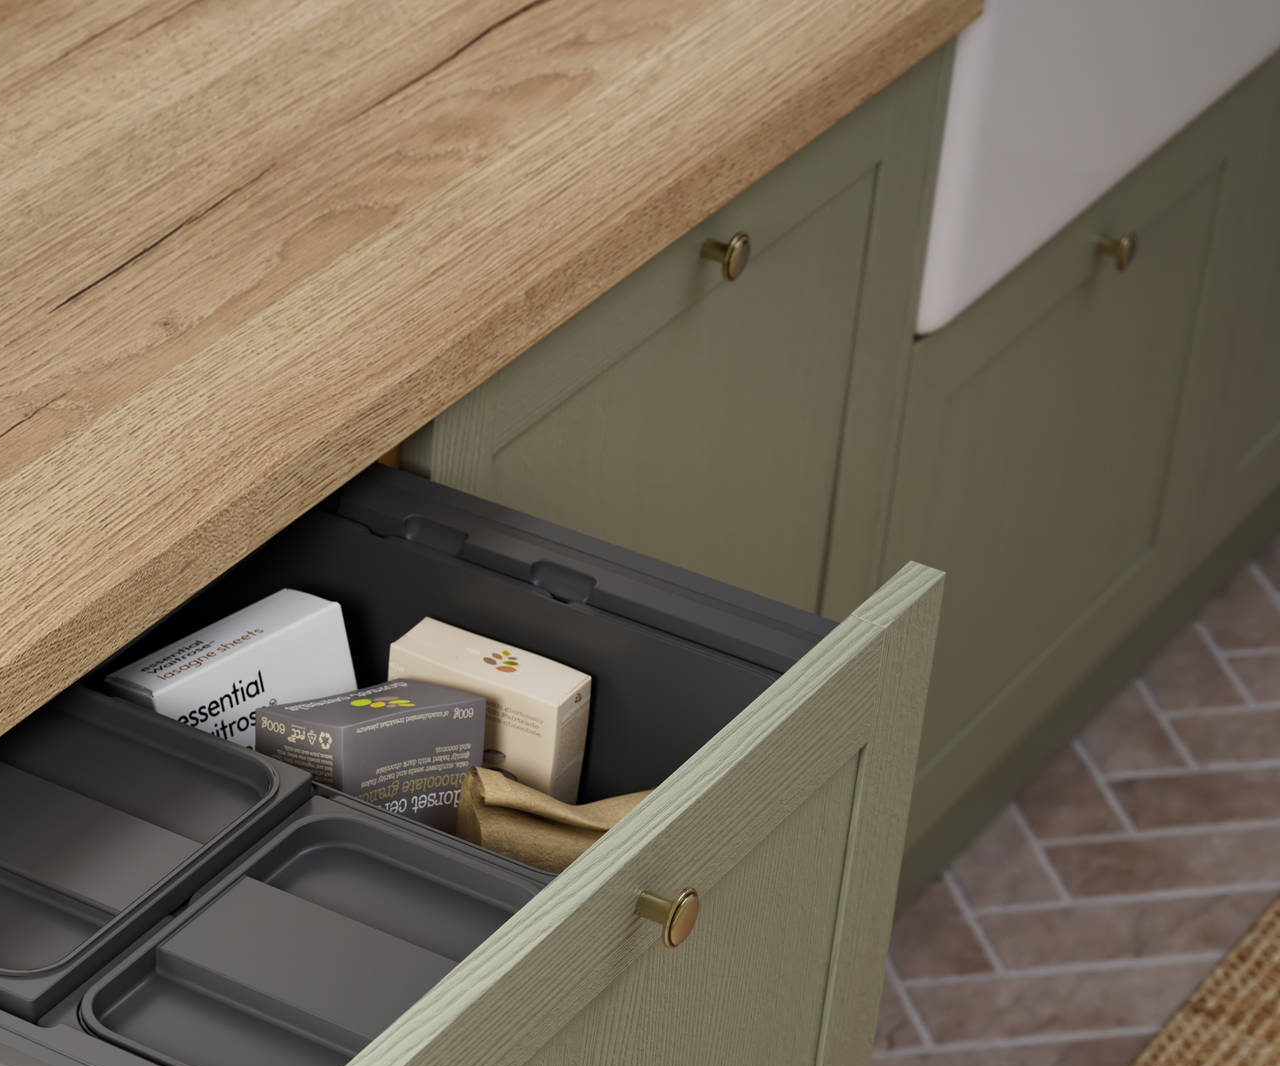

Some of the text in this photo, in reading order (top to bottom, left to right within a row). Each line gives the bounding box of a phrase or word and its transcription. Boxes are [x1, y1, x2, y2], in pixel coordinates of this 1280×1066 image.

[157, 629, 264, 680] lasagne sheets
[178, 669, 265, 727] essential
[261, 716, 286, 735] 600g
